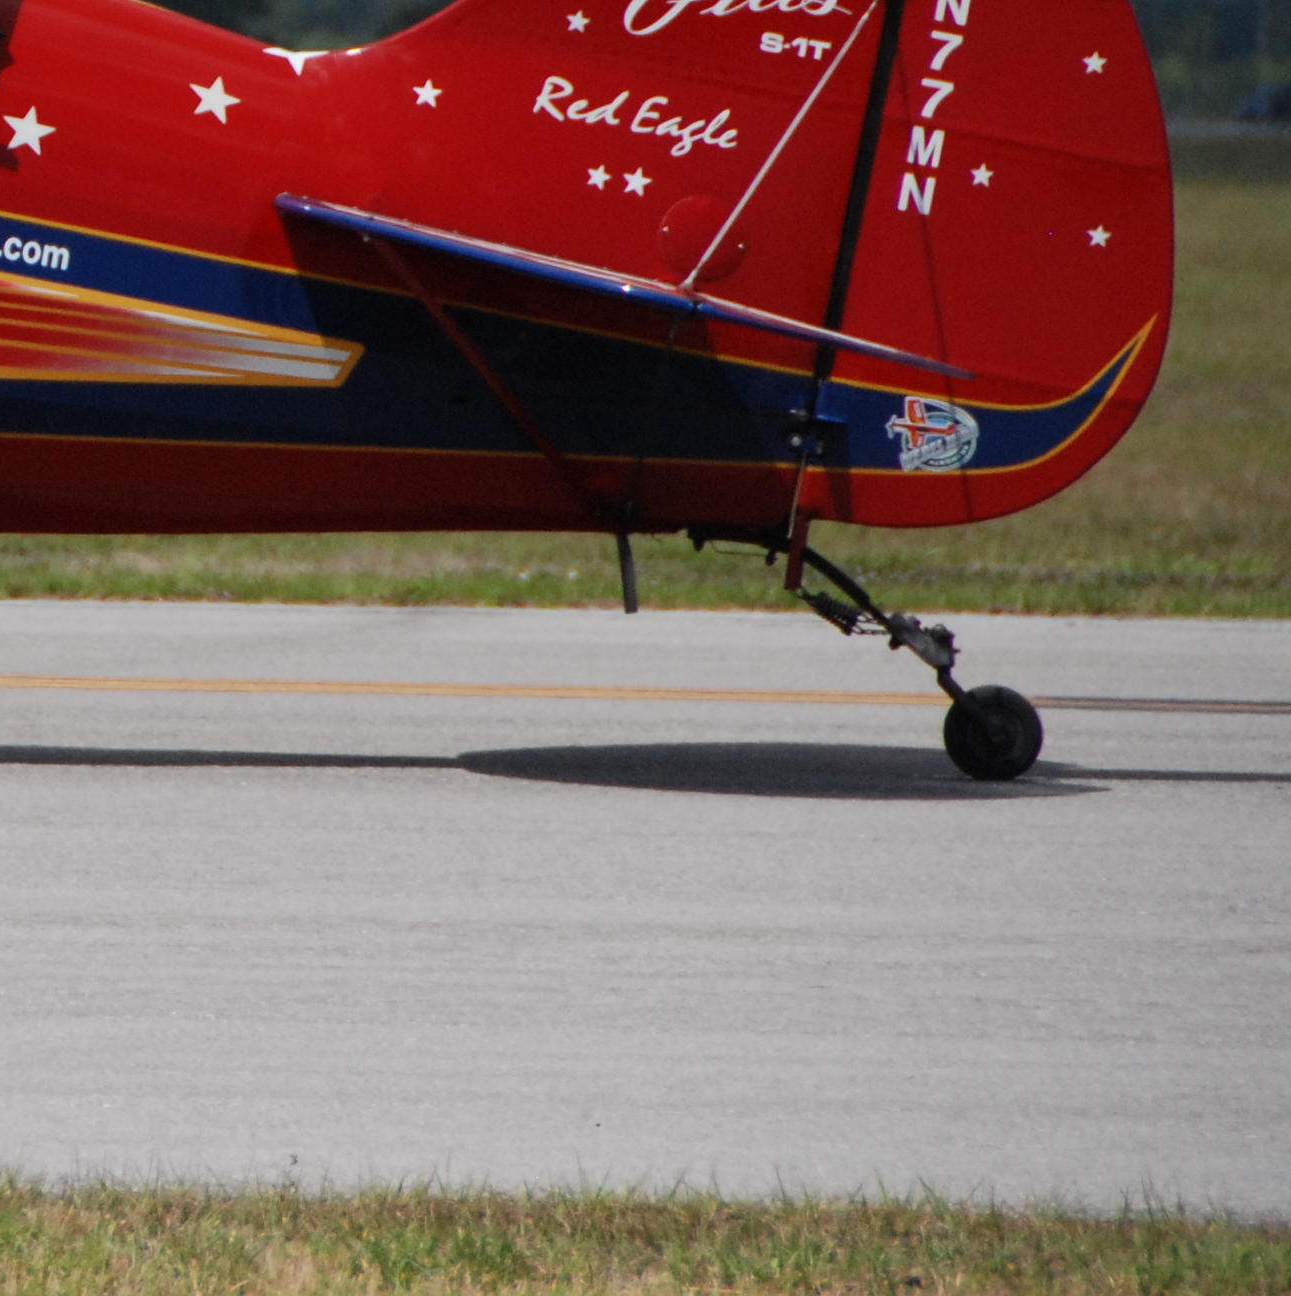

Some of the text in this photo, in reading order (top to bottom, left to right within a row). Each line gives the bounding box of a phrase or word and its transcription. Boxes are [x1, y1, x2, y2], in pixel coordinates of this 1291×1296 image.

[759, 32, 831, 61] S-1T
[533, 76, 739, 156] Red Eagle
